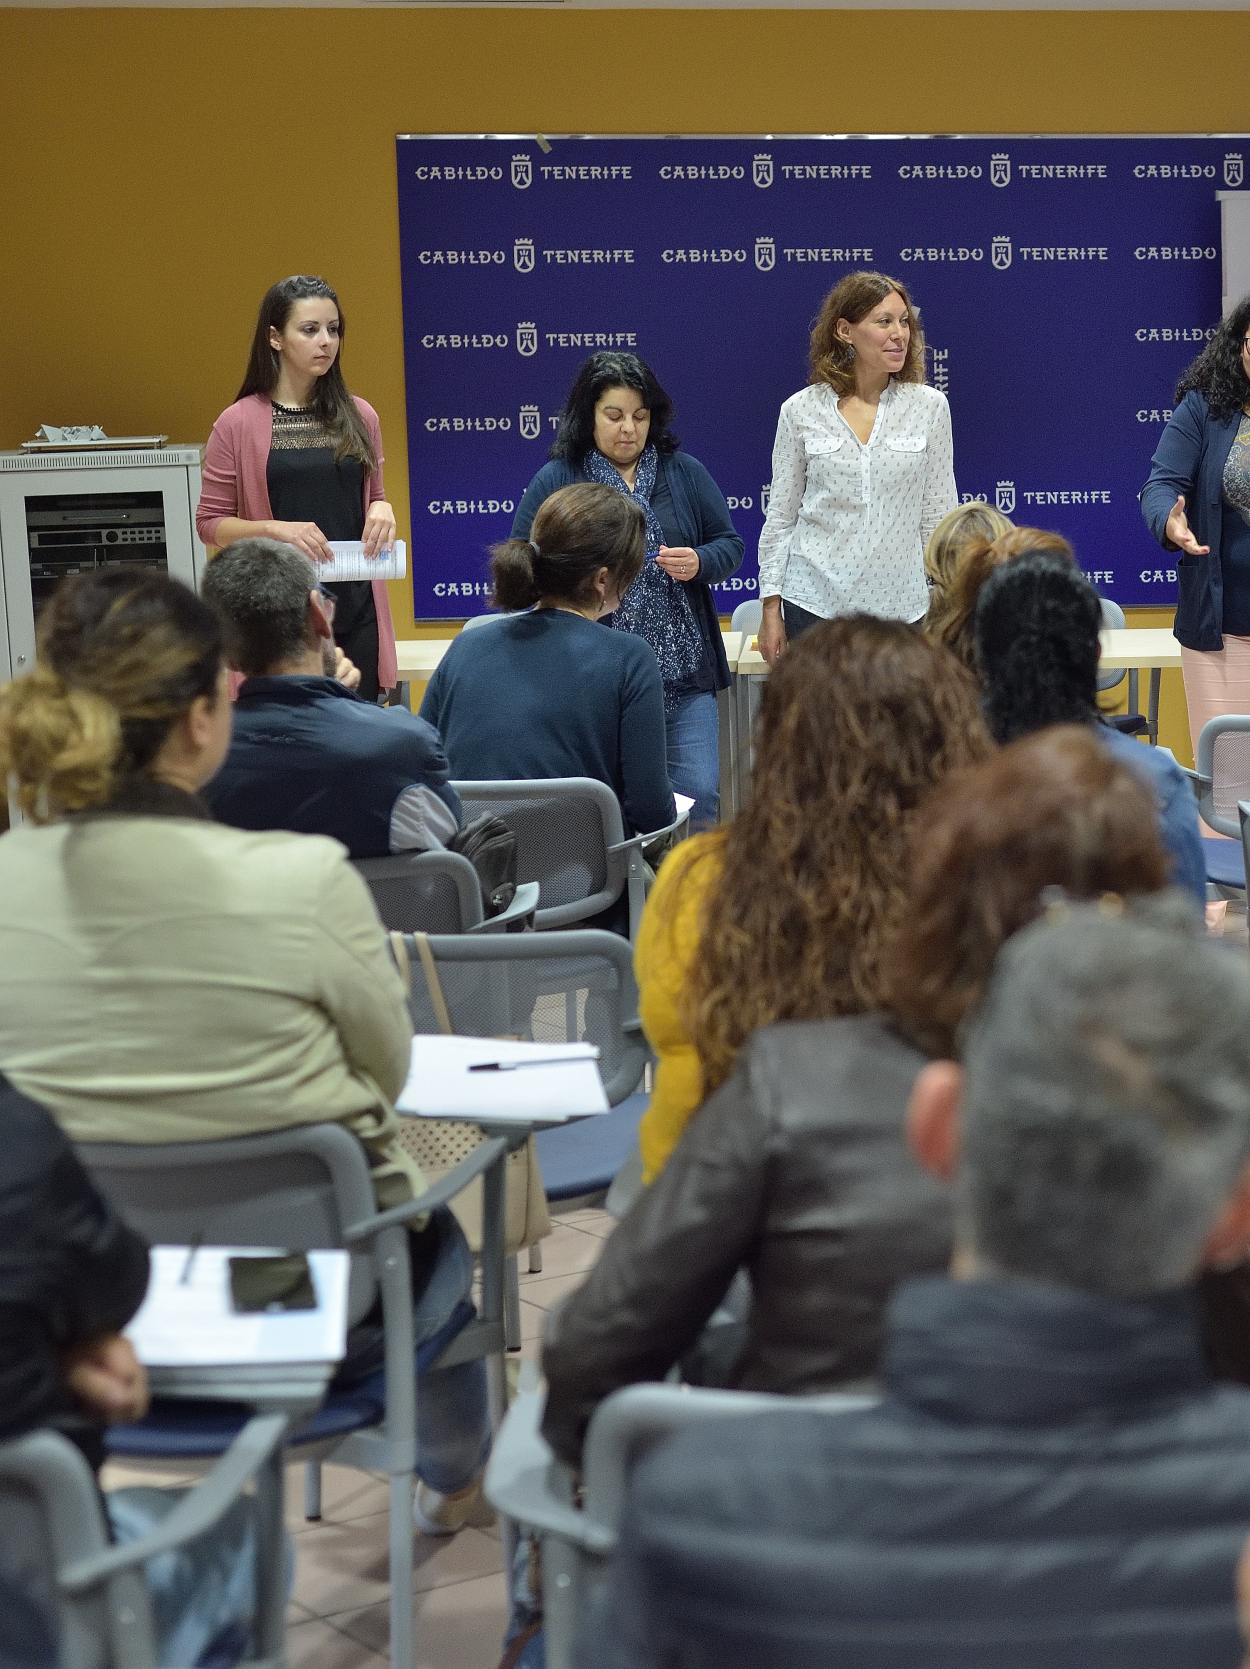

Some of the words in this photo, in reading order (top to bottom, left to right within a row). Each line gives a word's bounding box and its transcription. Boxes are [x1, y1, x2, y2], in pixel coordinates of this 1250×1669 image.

[415, 166, 503, 180] CABILDO
[540, 166, 633, 180] TENERIFE
[658, 165, 745, 180] CABILDO
[781, 165, 872, 179] TENERIFE
[897, 165, 983, 179] CABILDO
[1018, 165, 1108, 178] TENERIFE
[1132, 164, 1216, 178] CABILDO
[417, 250, 506, 265] CABILDO
[542, 249, 635, 264] TENERIFE
[660, 249, 747, 263] CABILDO
[783, 248, 874, 262] TENERIFE
[899, 247, 984, 262] CABILDO
[1019, 247, 1109, 261] TENERIFE
[1133, 246, 1217, 260] CABILDO
[420, 334, 509, 349] CABILDO
[545, 332, 637, 347] TENERIFE
[424, 417, 512, 432] CABILDO
[1023, 490, 1111, 505] TENERIFE
[427, 499, 515, 515] CABILDO
